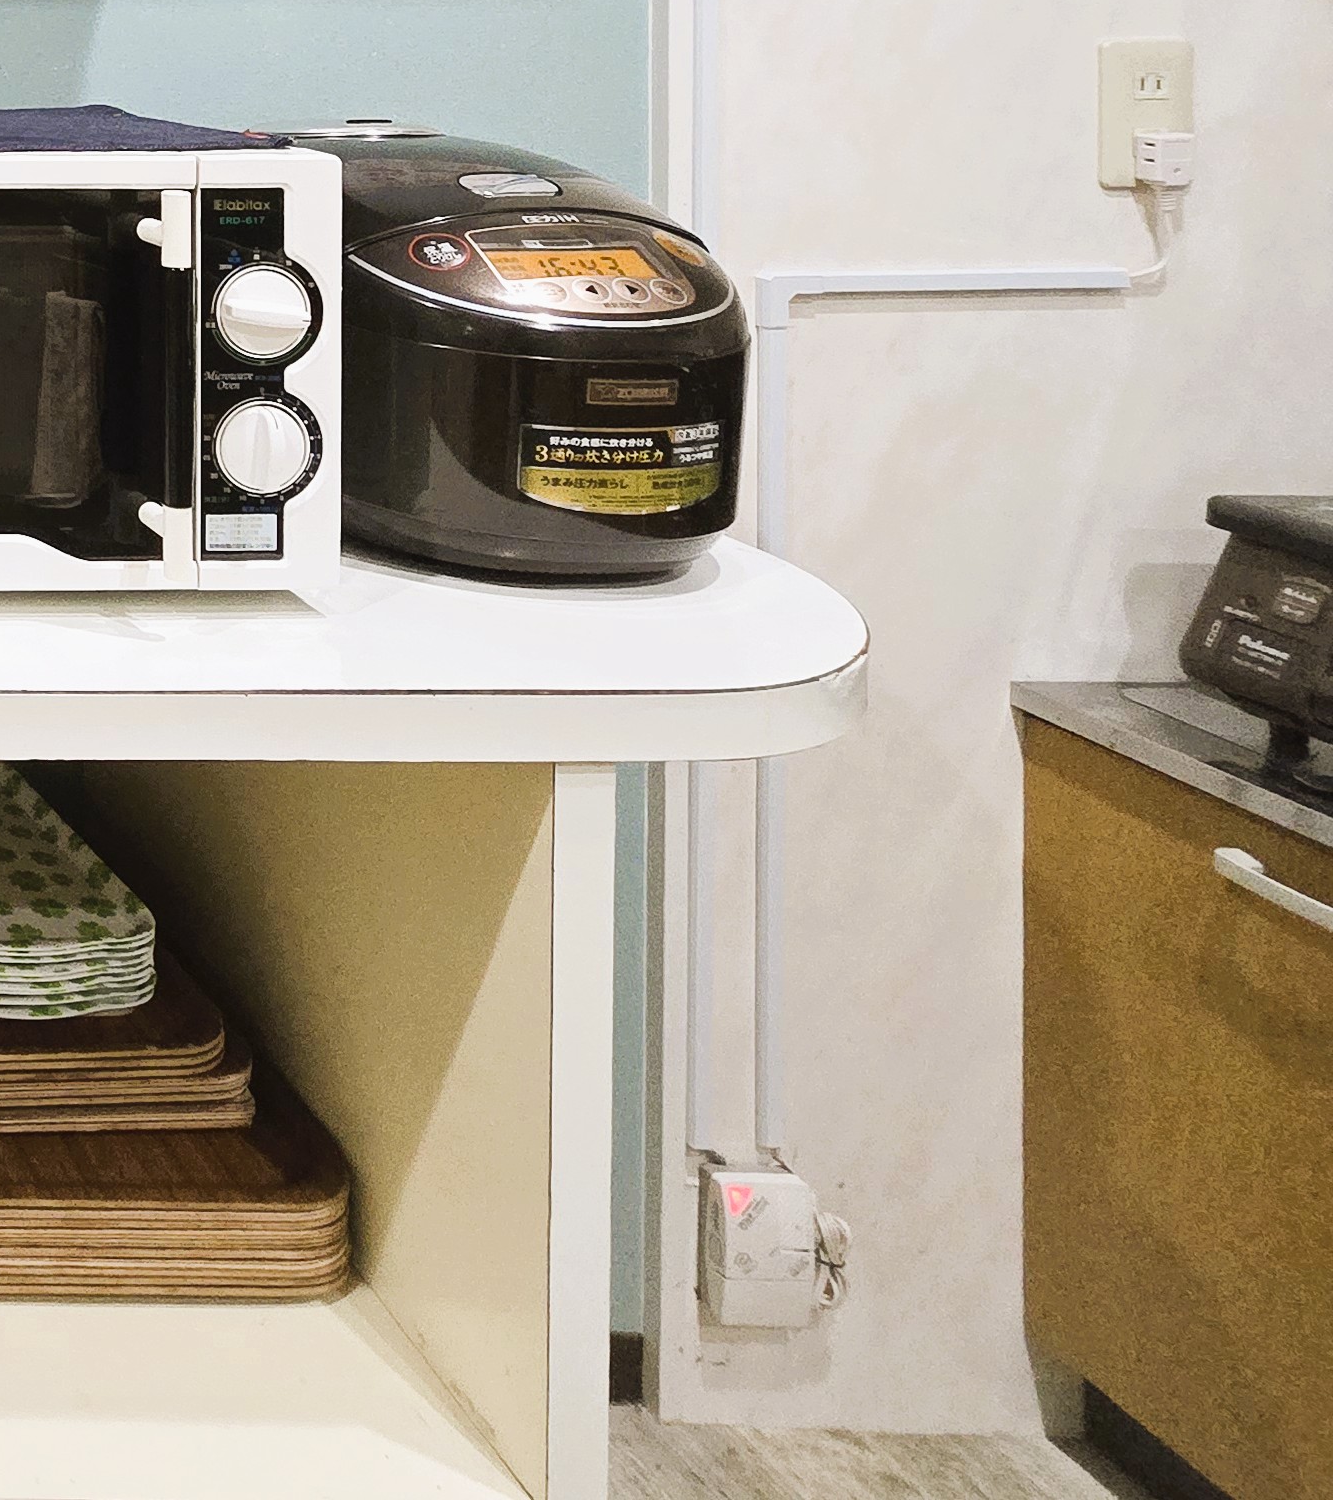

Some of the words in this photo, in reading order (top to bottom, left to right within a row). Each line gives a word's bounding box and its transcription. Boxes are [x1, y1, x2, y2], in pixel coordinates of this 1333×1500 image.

[219, 216, 266, 225] ERD-617
[539, 256, 627, 277] 16:43
[203, 370, 254, 382] Microwave
[216, 380, 241, 390] Oven
[535, 445, 665, 464] 3通りの炊き分け圧力
